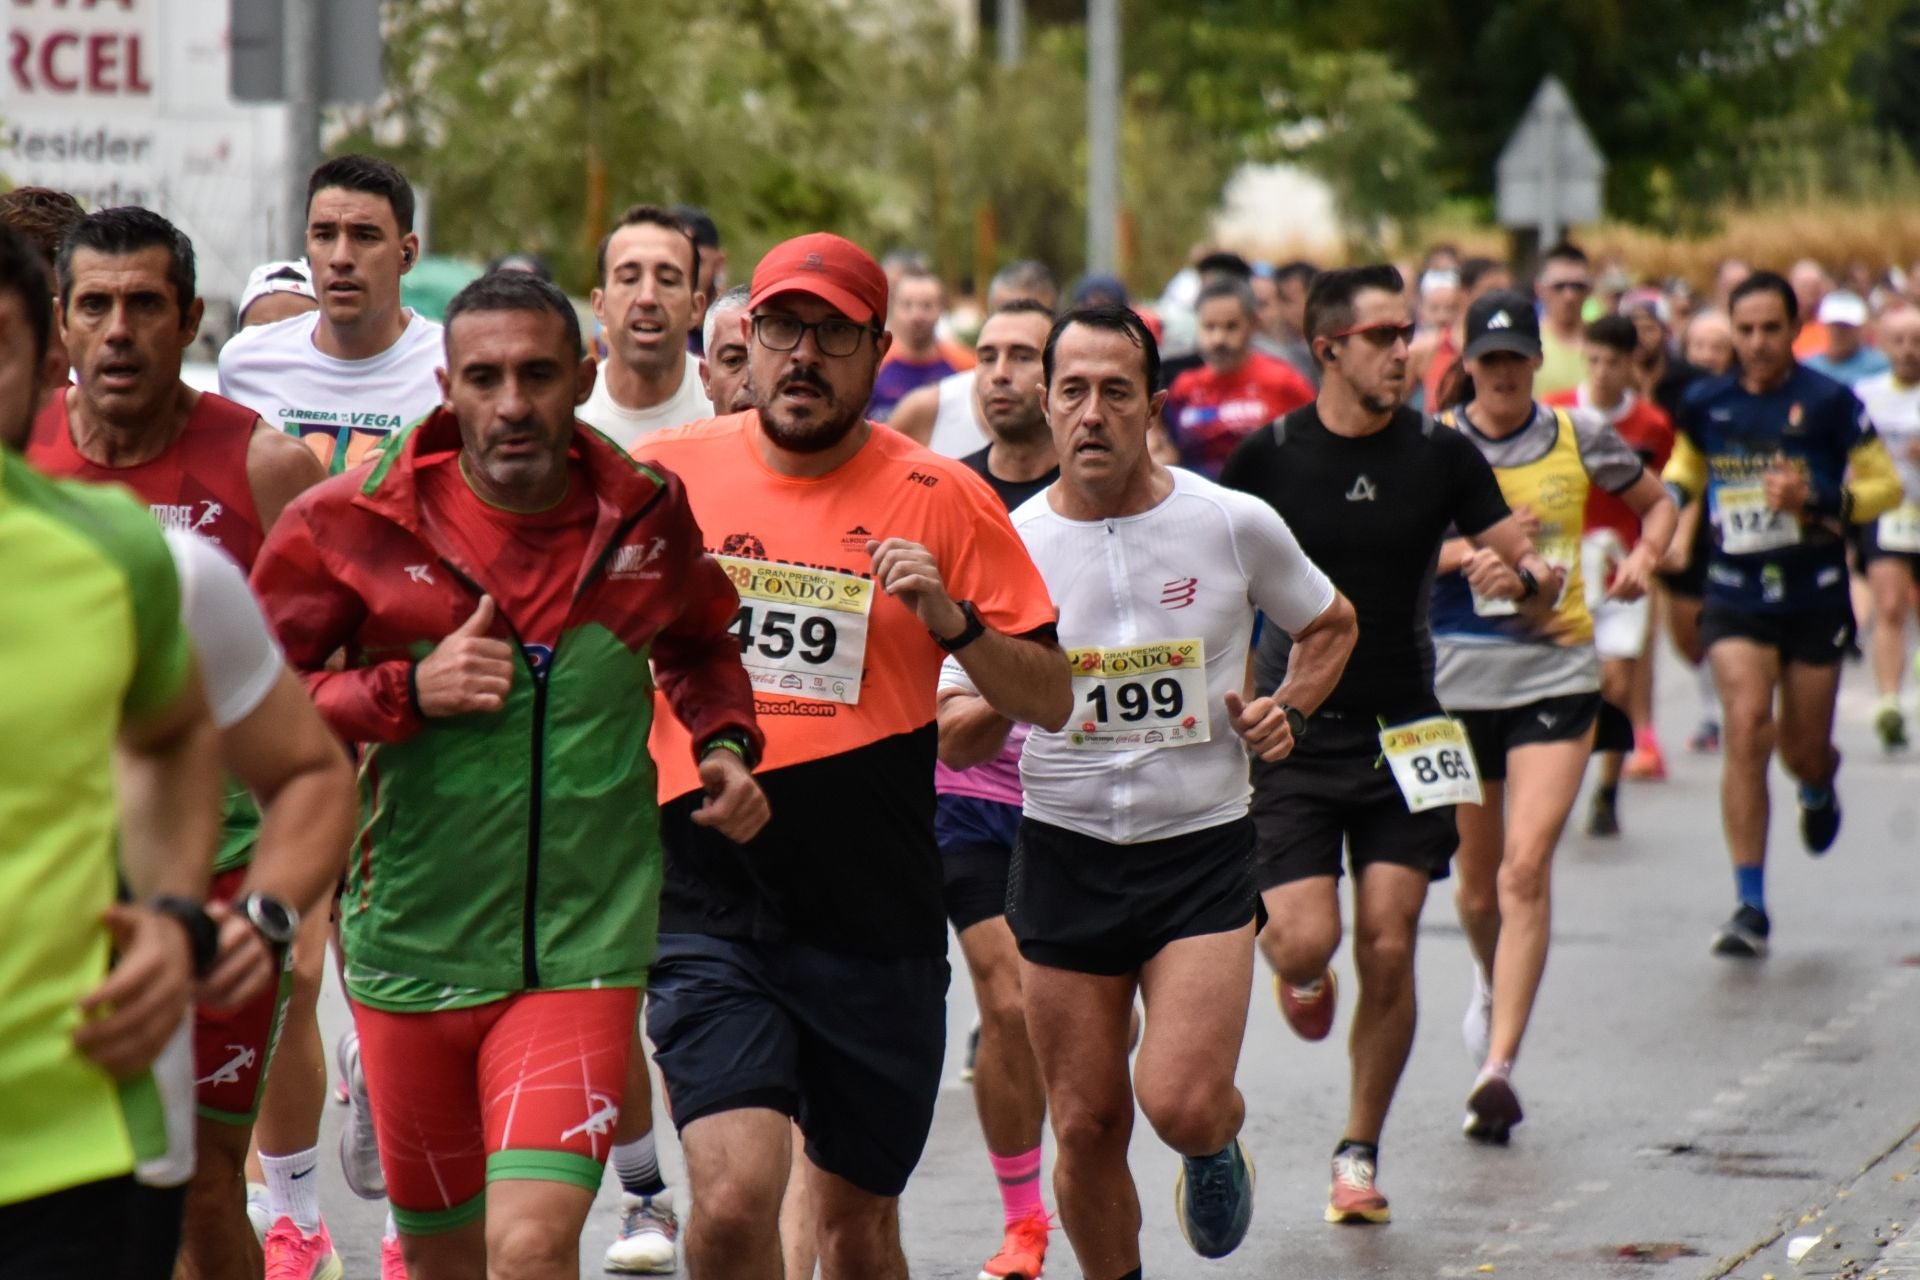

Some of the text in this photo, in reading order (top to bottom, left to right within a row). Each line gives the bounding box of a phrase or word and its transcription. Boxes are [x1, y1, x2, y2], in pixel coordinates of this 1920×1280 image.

[278, 408, 338, 422] CARRERA
[350, 412, 401, 428] VEGA
[757, 568, 786, 579] GRAN
[788, 571, 828, 586] PREMIO
[750, 575, 835, 600] FONDO
[726, 605, 837, 665] 459
[1103, 651, 1129, 660] GRAN
[1130, 645, 1165, 657] PREMIO
[753, 701, 837, 717] tacol.com
[1086, 677, 1184, 724] 199
